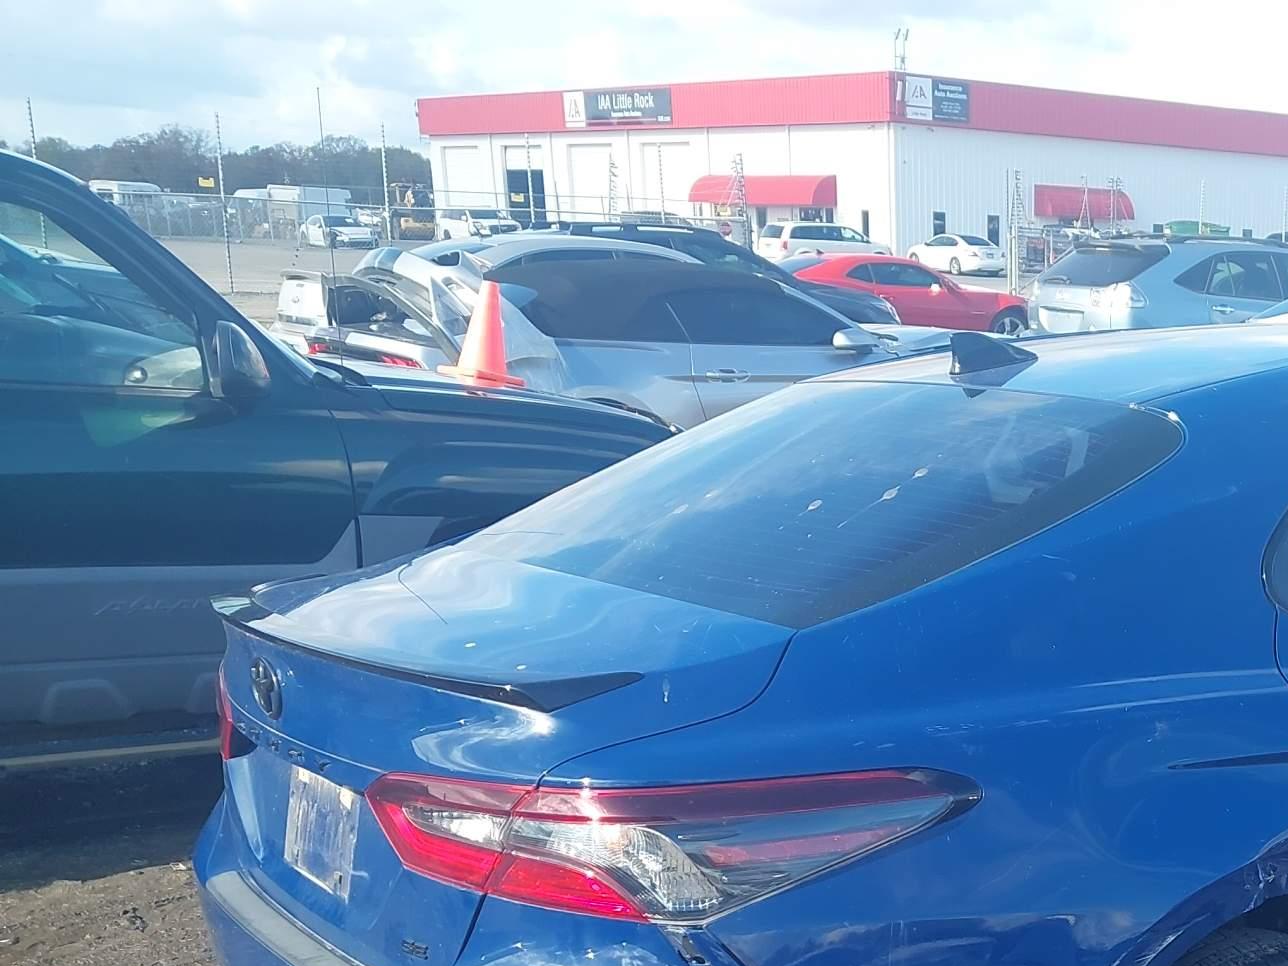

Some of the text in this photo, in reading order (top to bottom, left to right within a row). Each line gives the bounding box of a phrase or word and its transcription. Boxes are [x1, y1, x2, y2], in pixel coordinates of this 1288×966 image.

[598, 94, 611, 110] IAA
[612, 93, 632, 109] Little
[634, 92, 655, 108] Rock
